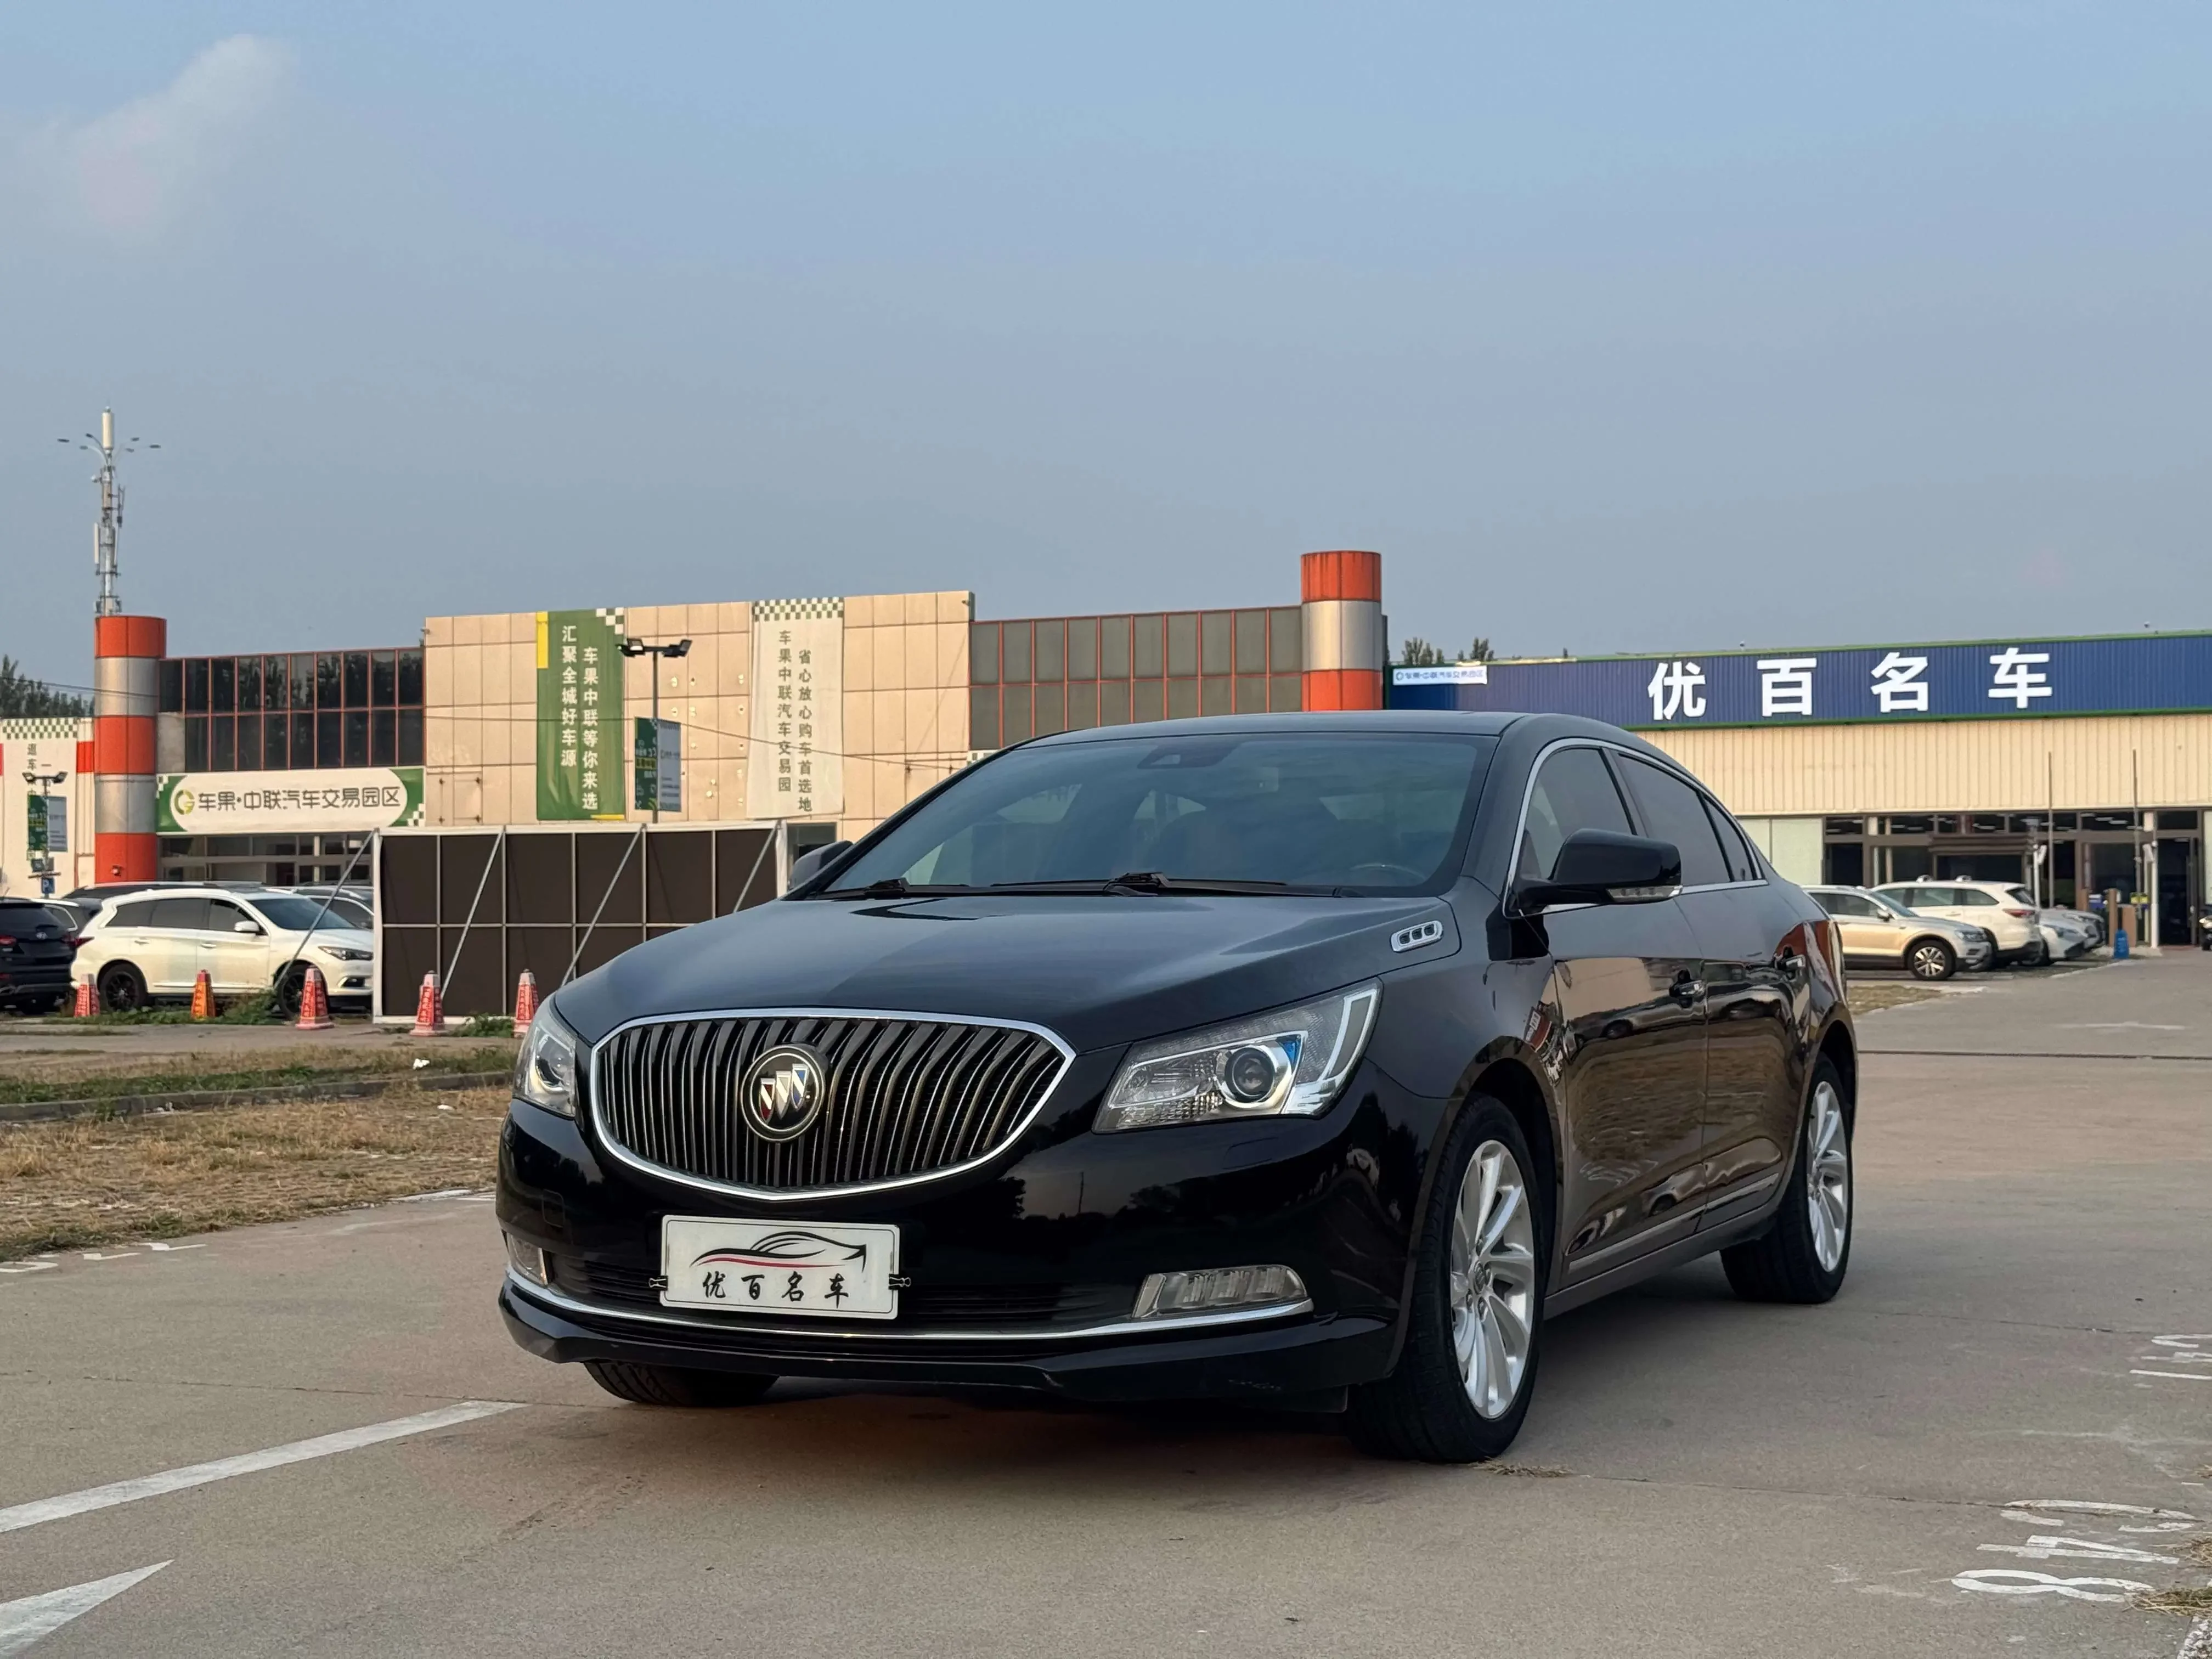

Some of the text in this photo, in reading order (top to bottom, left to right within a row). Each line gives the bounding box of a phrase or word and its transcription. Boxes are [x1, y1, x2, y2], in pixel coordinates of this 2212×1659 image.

[561, 624, 578, 768] 汇聚全城好车源
[582, 646, 599, 810] 车果中联等你来选
[777, 629, 792, 792] 车果中联汽车交易园
[798, 648, 813, 812] 省心放心购车首选地
[1647, 647, 2052, 721] 优百名车
[702, 1271, 850, 1309] 优百名车
